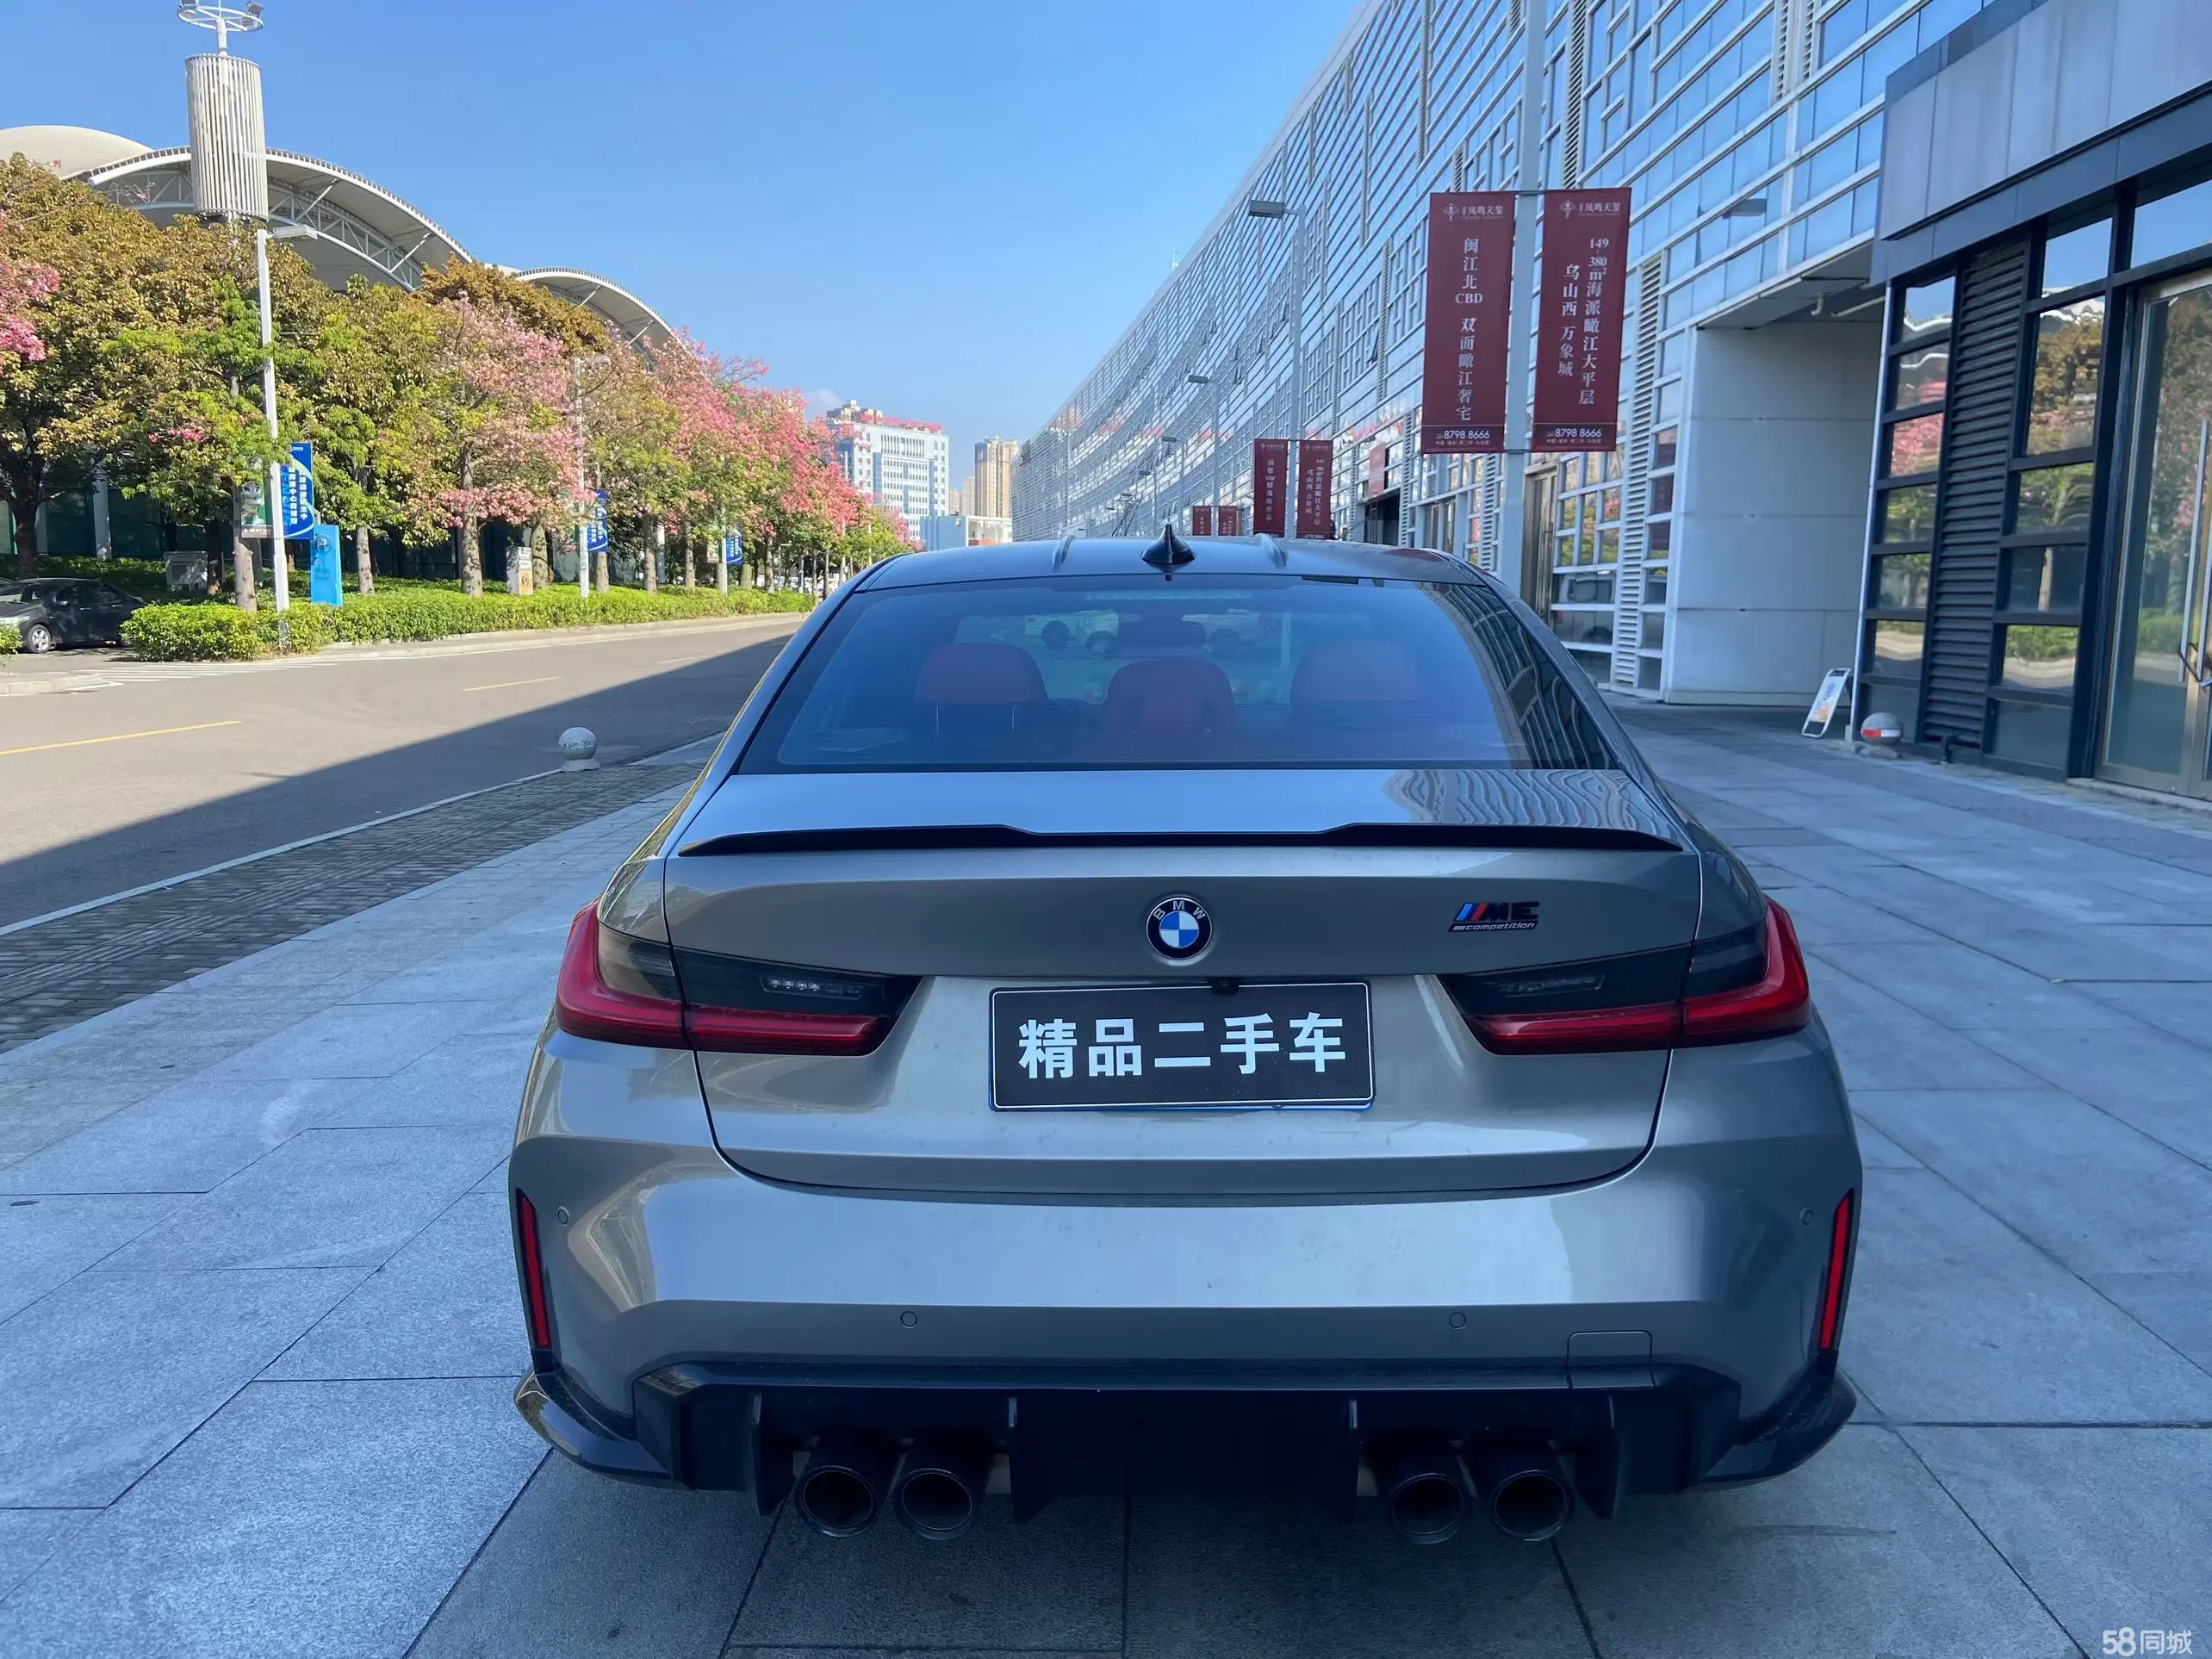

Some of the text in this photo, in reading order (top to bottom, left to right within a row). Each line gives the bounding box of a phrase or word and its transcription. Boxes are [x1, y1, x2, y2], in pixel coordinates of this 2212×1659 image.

[1444, 430, 1465, 439] 8798
[1467, 430, 1490, 439] 8666
[1555, 428, 1577, 438] 8798
[1579, 428, 1601, 438] 8666
[1153, 900, 1207, 921] BMW
[1465, 922, 1535, 931] competition
[1018, 1011, 1346, 1079] 精品二手车
